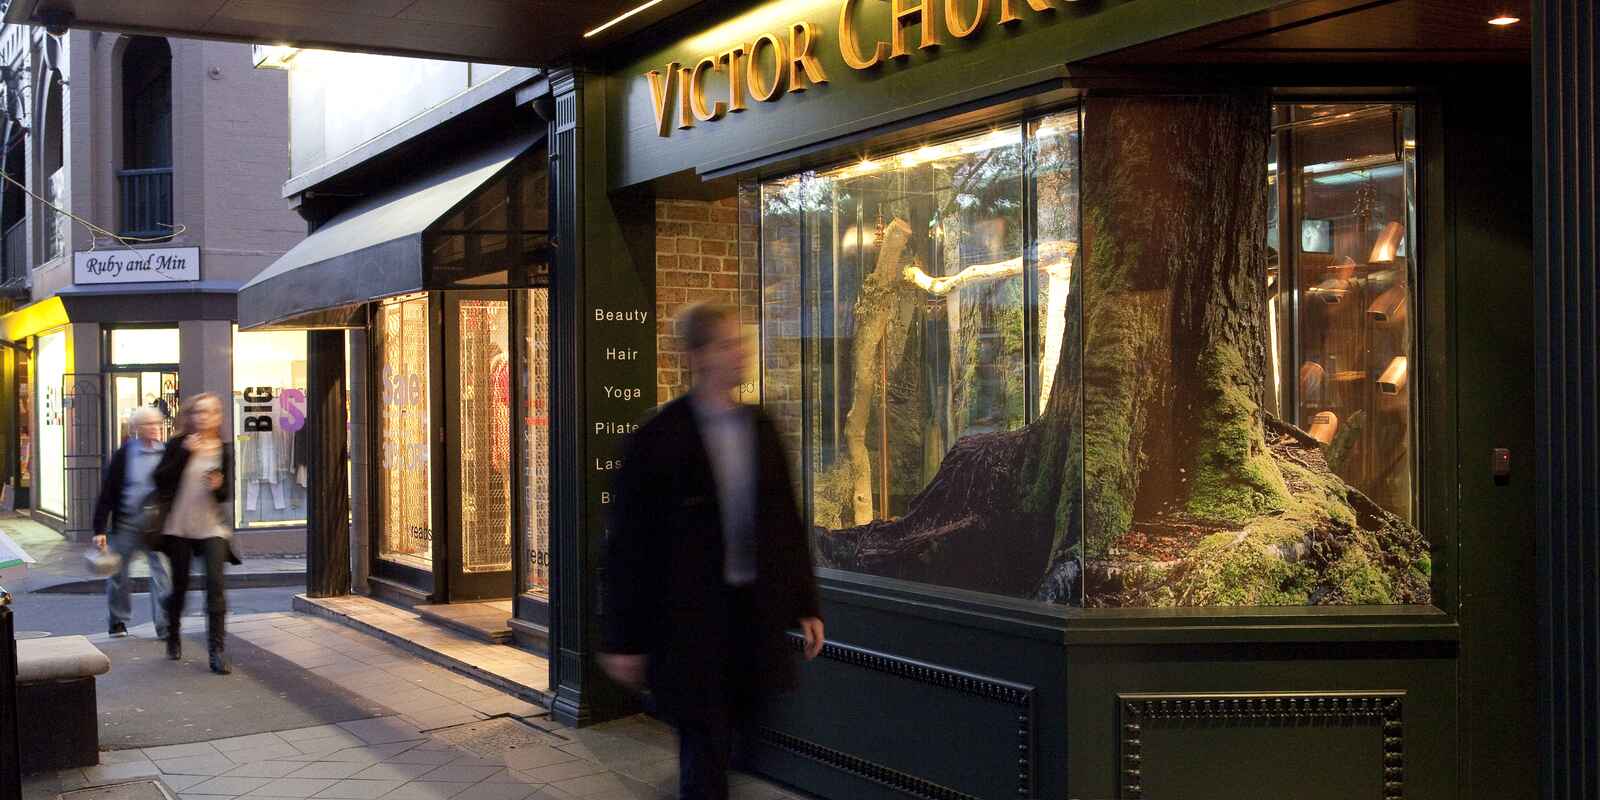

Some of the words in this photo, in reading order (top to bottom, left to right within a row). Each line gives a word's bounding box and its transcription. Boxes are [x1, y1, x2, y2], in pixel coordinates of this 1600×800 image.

[644, 21, 830, 138] VICTOR
[86, 255, 124, 277] Ruby
[126, 253, 155, 271] and
[155, 255, 187, 271] Min
[595, 308, 648, 324] Beauty
[606, 347, 638, 361] Hair
[383, 362, 420, 405] Sale
[604, 385, 641, 401] Yoga
[243, 386, 272, 432] BIG
[595, 422, 641, 435] Pilate
[596, 458, 623, 471] Las
